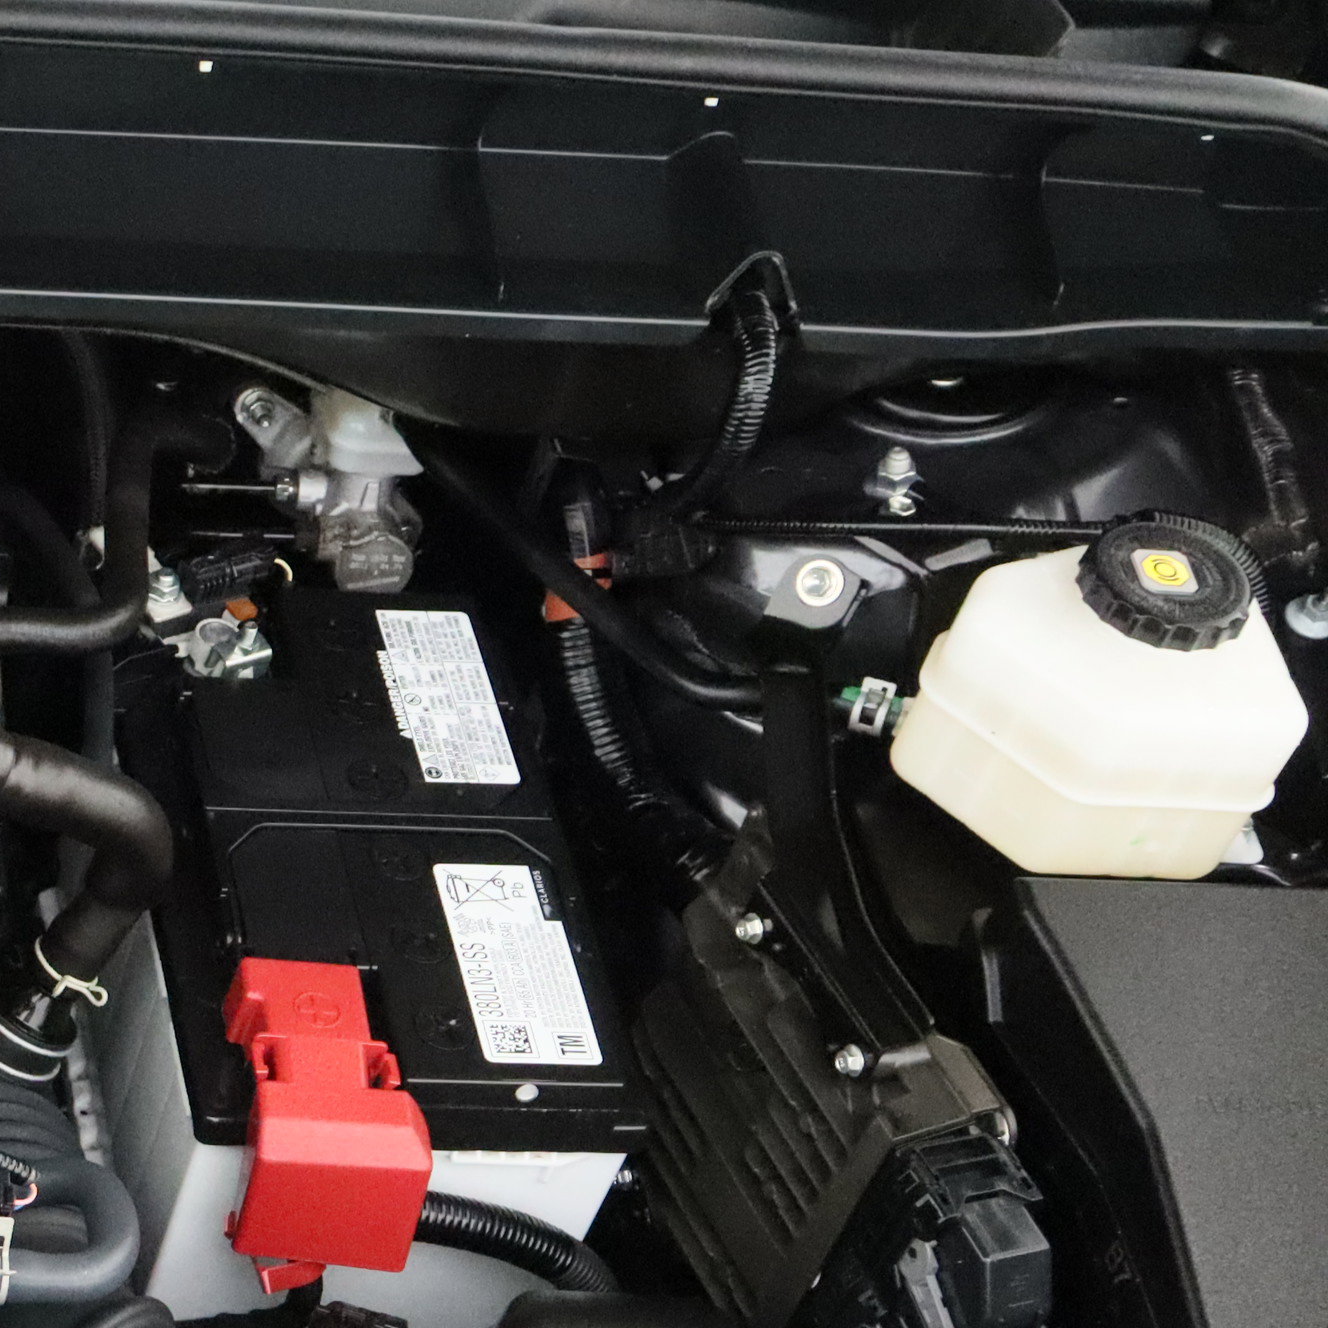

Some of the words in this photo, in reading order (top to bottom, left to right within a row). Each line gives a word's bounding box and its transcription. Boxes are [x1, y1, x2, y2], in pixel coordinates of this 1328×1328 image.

[509, 882, 527, 897] Pb
[531, 870, 549, 902] CLARIOS
[459, 942, 505, 1017] 380LN3-ISS
[556, 1034, 588, 1054] TM
